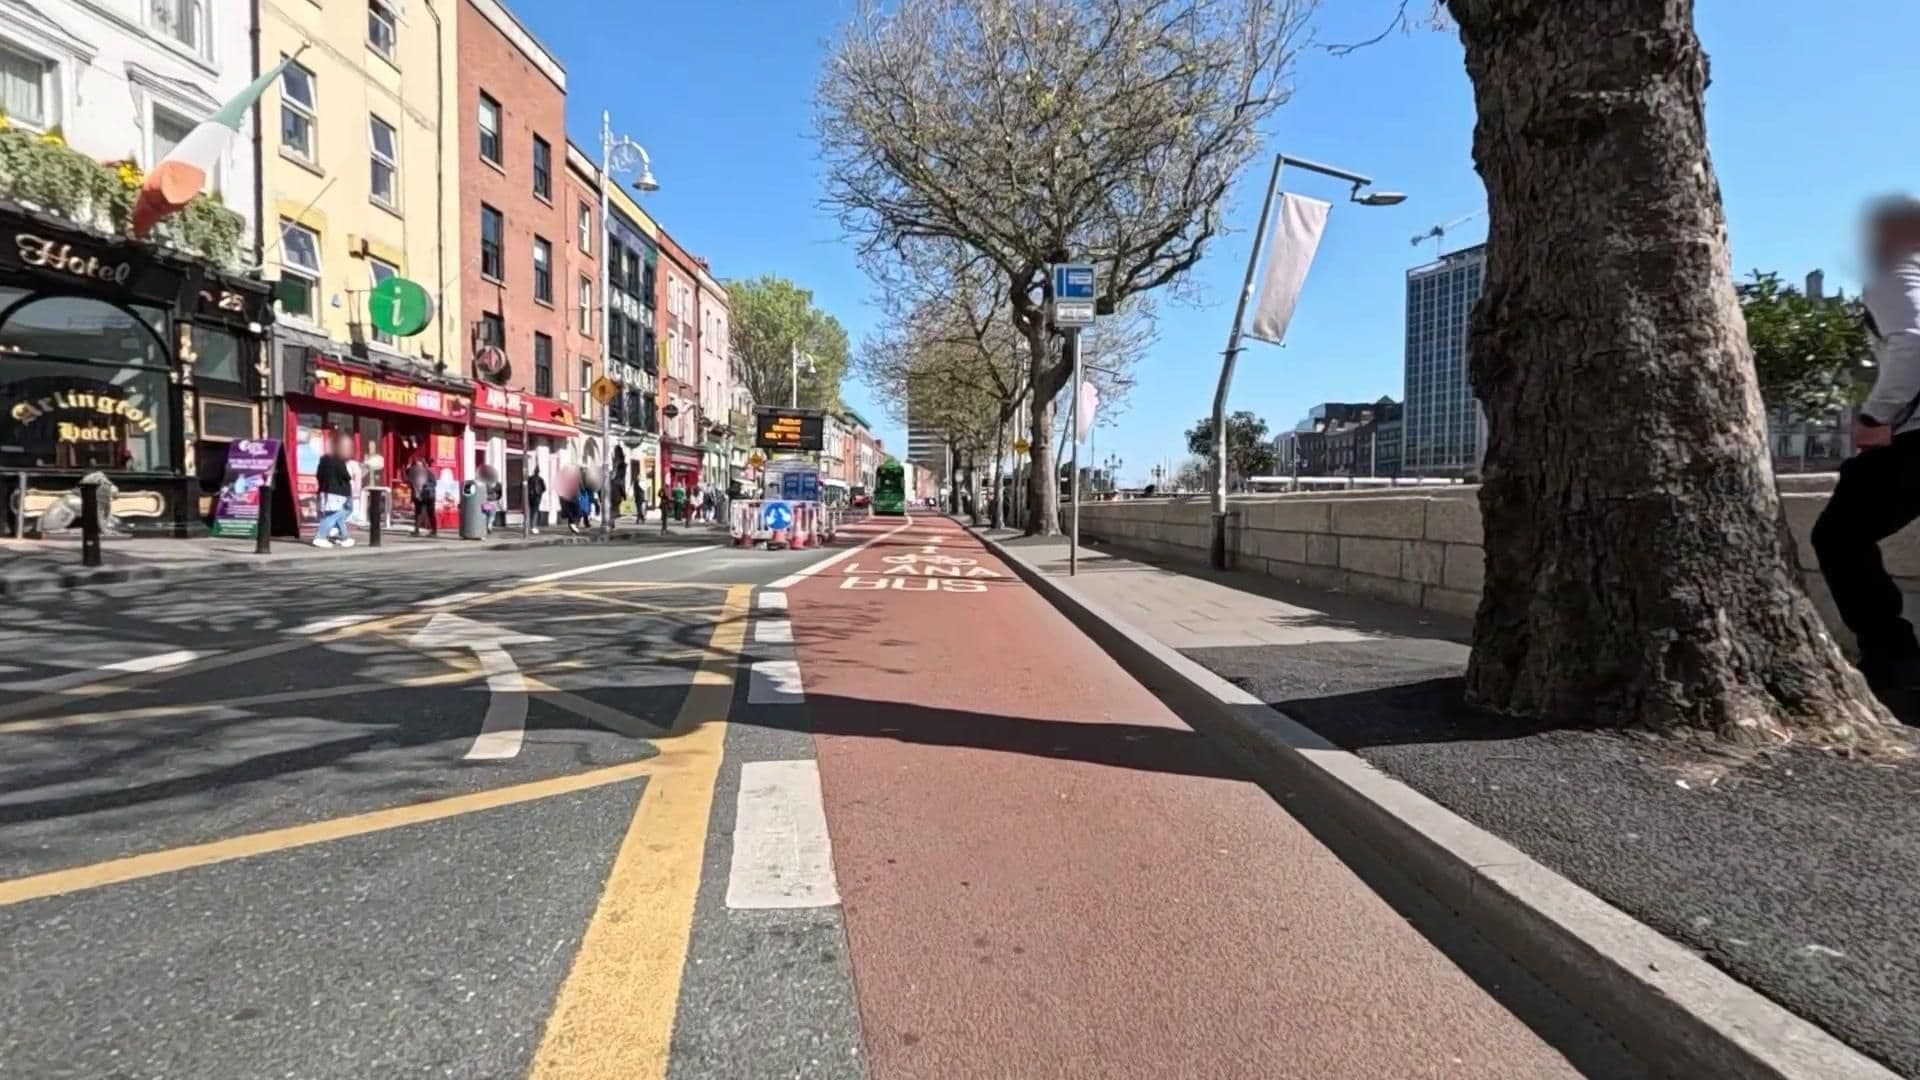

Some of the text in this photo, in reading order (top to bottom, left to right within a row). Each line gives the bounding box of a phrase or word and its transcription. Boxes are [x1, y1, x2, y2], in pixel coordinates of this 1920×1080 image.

[16, 233, 131, 286] Hotel
[219, 291, 245, 312] 25
[10, 389, 158, 433] Arlington
[56, 421, 119, 443] Hotel
[843, 562, 1001, 578] LANA
[839, 576, 988, 593] BUS
